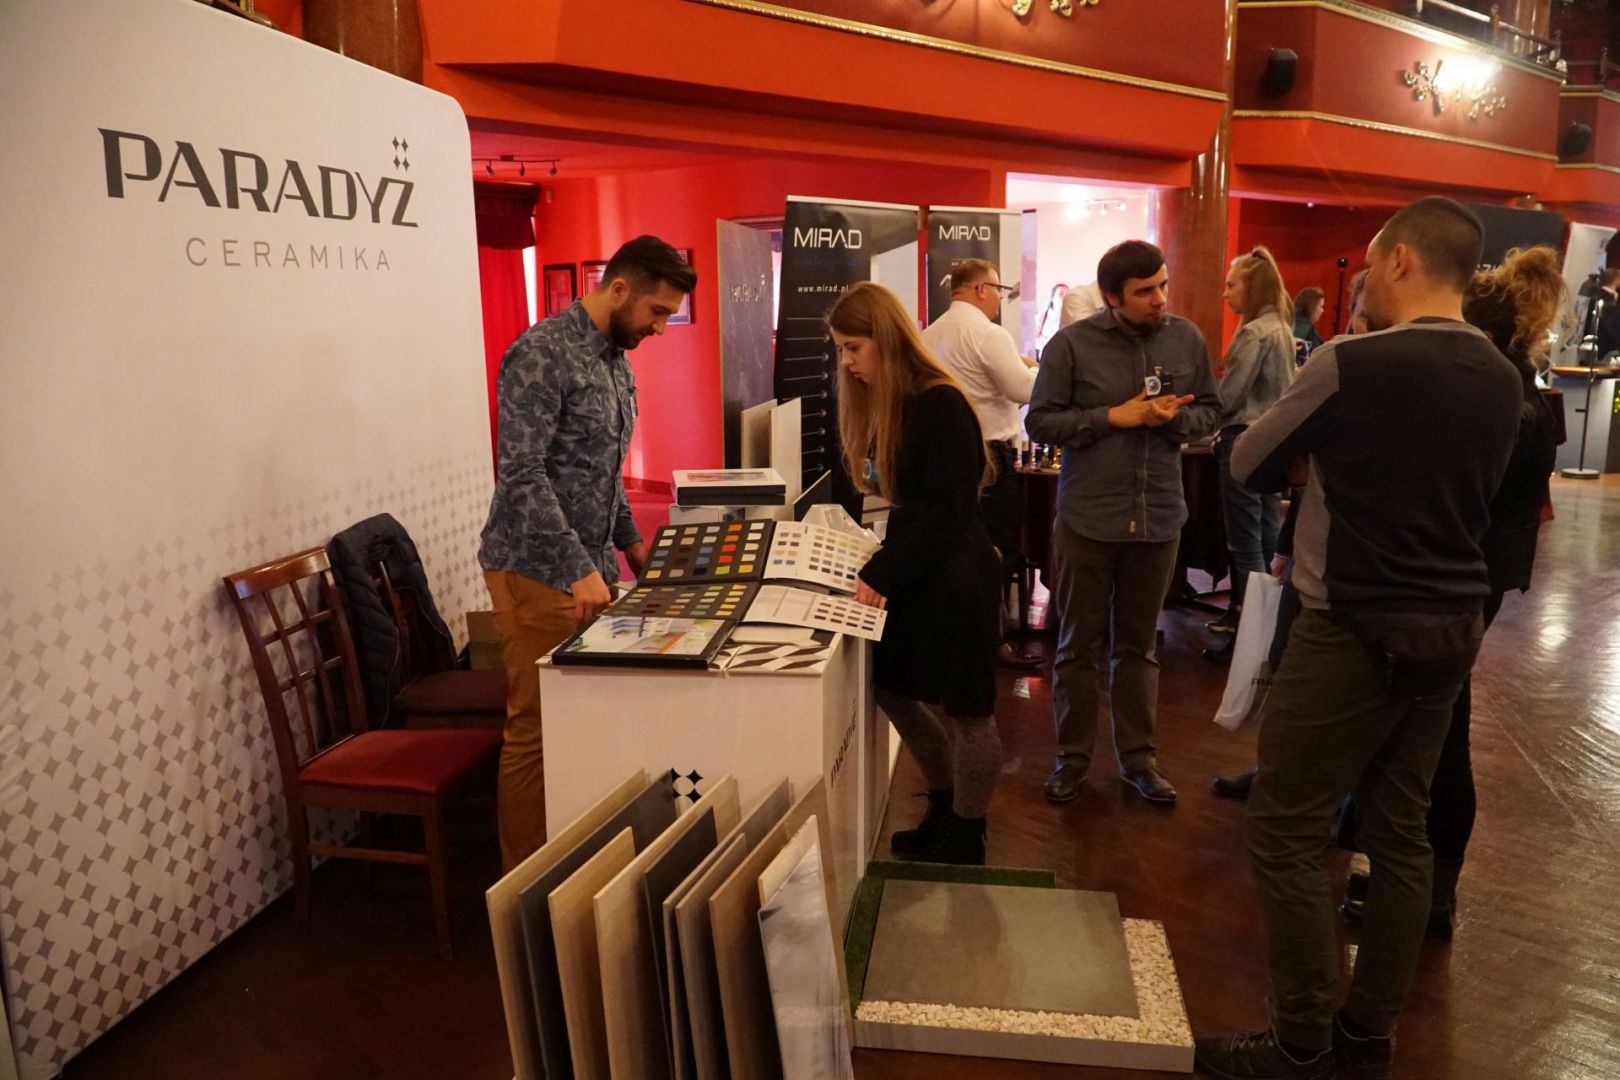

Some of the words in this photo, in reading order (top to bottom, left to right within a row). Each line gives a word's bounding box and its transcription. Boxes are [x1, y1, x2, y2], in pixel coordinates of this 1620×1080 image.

[793, 226, 863, 250] MIRAD
[938, 224, 992, 241] MIRAD
[185, 237, 391, 271] CERAMIKA
[797, 284, 850, 294] www.mirad.pl
